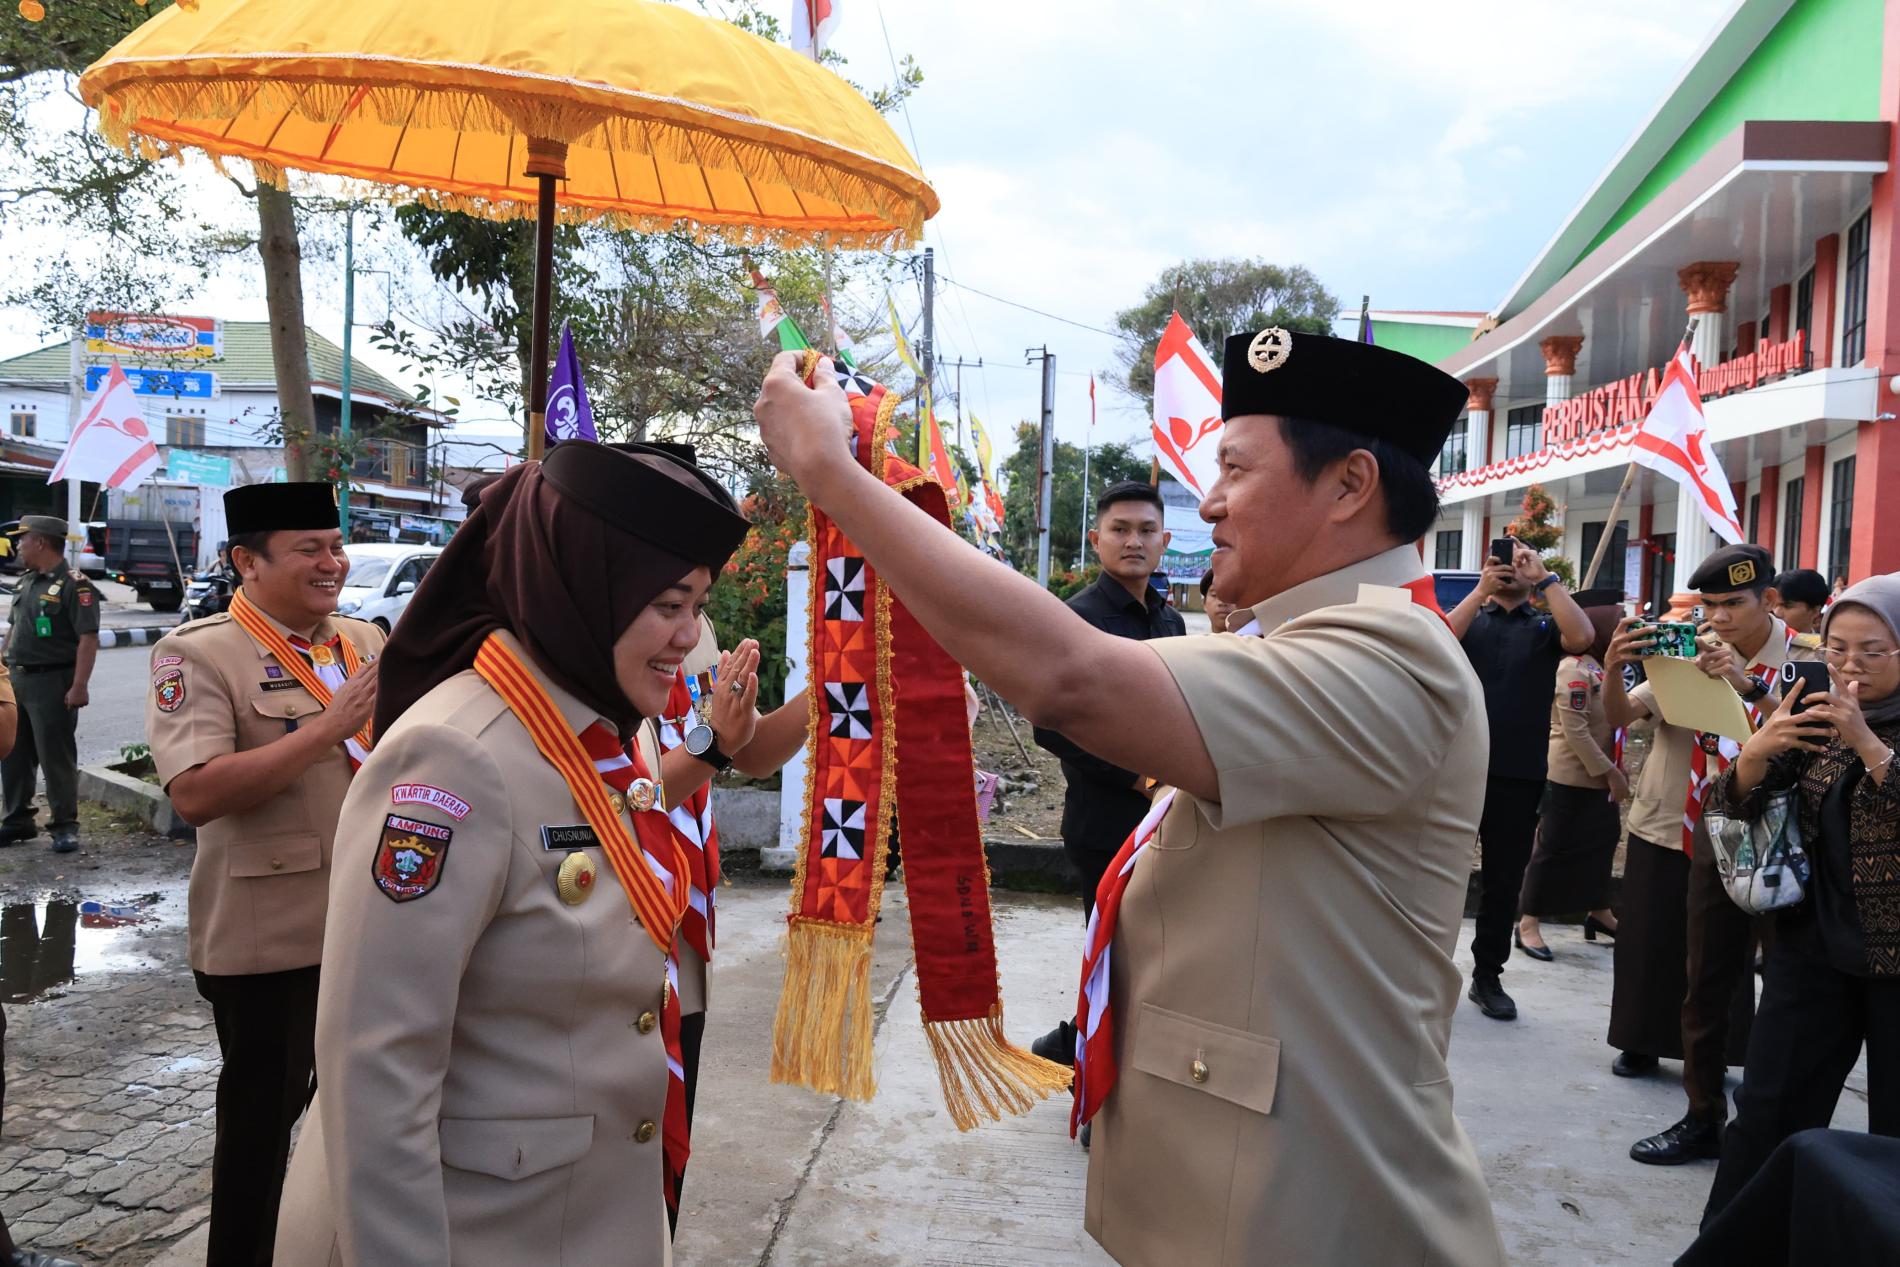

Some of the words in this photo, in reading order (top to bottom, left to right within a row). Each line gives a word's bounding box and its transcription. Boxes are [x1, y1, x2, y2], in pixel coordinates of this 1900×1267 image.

[1541, 360, 1676, 444] PERPUSTAKA
[1757, 328, 1806, 379] Barat
[394, 787, 432, 801] KWARTIR
[432, 791, 468, 818] DAERAH
[388, 817, 451, 840] LAMPUNG
